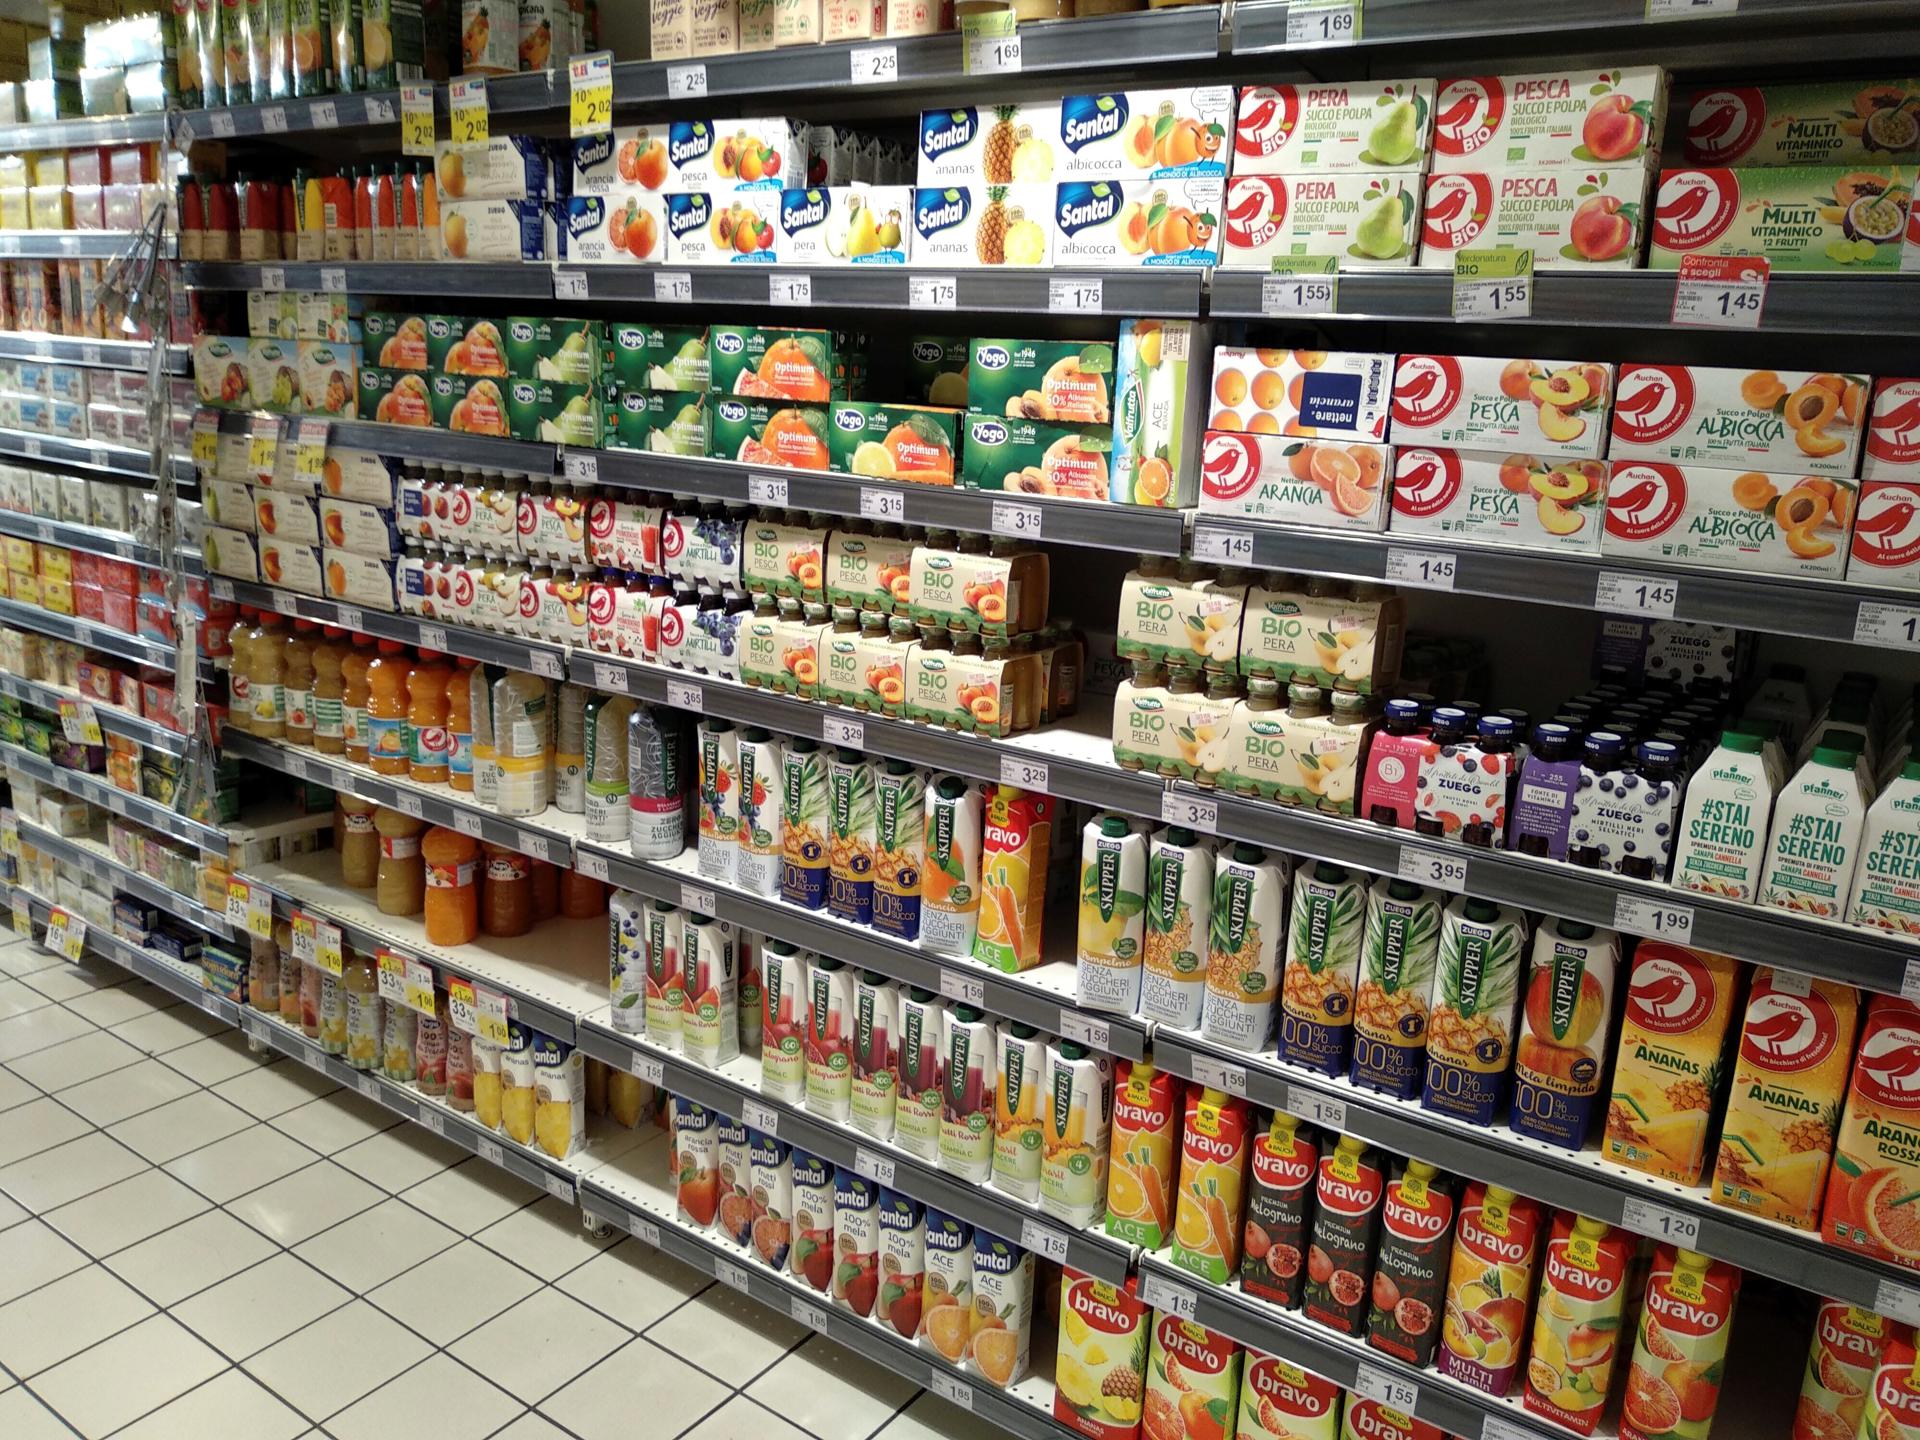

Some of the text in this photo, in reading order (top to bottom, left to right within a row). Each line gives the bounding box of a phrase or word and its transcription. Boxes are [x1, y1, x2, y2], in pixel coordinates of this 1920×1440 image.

[1307, 89, 1348, 107] PERA
[1451, 86, 1478, 94] Auchan
[1513, 79, 1571, 101] PESCA
[1306, 108, 1372, 120] SUCCO E POLPA
[1066, 115, 1118, 143] Santal
[1305, 122, 1337, 130] BIOLOGICO
[1787, 121, 1837, 138] MULTI
[925, 117, 969, 152] Santal
[672, 132, 709, 159] Santal
[1261, 132, 1288, 155] BIO
[1775, 138, 1843, 150] VITAMINICO
[936, 164, 974, 174] ananas
[1067, 158, 1122, 170] albicocca
[682, 172, 708, 182] pesca
[1675, 177, 1706, 186] Auchan
[1296, 183, 1336, 200] PERA
[1501, 178, 1557, 197] PESCA
[672, 206, 708, 231] Santal
[784, 202, 824, 228] Santal
[919, 199, 962, 229] Santal
[1060, 199, 1113, 226] Santal
[1762, 208, 1816, 224] MULTI
[570, 210, 600, 232] Santal
[1252, 223, 1277, 246] BIO
[1451, 222, 1479, 248] BIO
[1751, 226, 1823, 237] VITAMINICO
[578, 242, 605, 250] arancia
[681, 242, 705, 253] pesca
[794, 241, 816, 250] pera
[929, 243, 968, 253] ananas
[1062, 243, 1116, 255] albicocca
[1763, 238, 1808, 246] 12 FRUTTI
[582, 251, 601, 259] rossa
[1684, 256, 1729, 267] Confronta
[1457, 265, 1478, 274] BIO
[1691, 268, 1721, 278] scegli
[512, 323, 533, 340] Yoga
[716, 333, 743, 354] Yoga
[977, 347, 1009, 369] Yoga
[1410, 362, 1435, 370] Auchan
[775, 362, 814, 374] Optimum
[1047, 380, 1097, 392] Optimum
[1634, 374, 1663, 382] Auchan
[1310, 397, 1354, 406] arancia
[1474, 393, 1494, 402] Succo
[1501, 394, 1519, 404] Polpa
[1125, 390, 1137, 439] Valfrutta
[1152, 403, 1163, 428] ACE
[1470, 404, 1519, 422] PESCA
[1717, 408, 1738, 417] Succo
[1747, 410, 1770, 420] Polpa
[972, 423, 1008, 444] Yoga
[1696, 417, 1785, 439] ALBICOCCA
[897, 443, 939, 456] Optimum
[1626, 472, 1655, 481] Auchan
[1259, 484, 1323, 505] ARANCIA
[1470, 495, 1519, 514] PESCA
[1688, 516, 1775, 540] ALBICOCCA
[686, 548, 717, 561] MIRTILLI
[923, 572, 953, 588] BIO
[923, 588, 953, 601] PESCA
[1142, 586, 1171, 599] Valfrutta
[1137, 604, 1173, 621] BIO
[1266, 601, 1302, 614] Valfrutta
[1139, 621, 1167, 633] PERA
[1261, 618, 1301, 637] BIO
[1264, 636, 1294, 650] PERA
[919, 674, 947, 690] BIO
[919, 688, 947, 700] PESCA
[1246, 737, 1284, 757] BIO
[706, 744, 715, 794] SKIPPER
[1248, 756, 1278, 770] PERA
[1713, 770, 1752, 784] pfanner
[1438, 779, 1482, 794] ZUEGG
[1804, 784, 1844, 799] pfanner
[884, 789, 896, 842] SKIPPER
[1597, 808, 1643, 823] ZUEGG
[1701, 799, 1751, 827] #STAI
[1591, 819, 1644, 834] MIRTILLI NERI
[1599, 826, 1635, 838] SELVATICI
[1690, 820, 1754, 848] SERENO
[1790, 814, 1841, 843] #STAI
[1098, 842, 1120, 850] ZUEGG
[1691, 841, 1716, 850] SPREMUTA
[1777, 835, 1846, 865] SERENO
[1694, 849, 1742, 865] CANAPA CANNELLA
[1100, 854, 1116, 911] SKIPPER
[1230, 880, 1247, 940] SKIPPER
[1462, 927, 1490, 938] ZUEGG
[978, 946, 1001, 960] ACE
[1082, 950, 1132, 967] Pompelmo
[1082, 964, 1112, 975] SENZA
[1460, 940, 1481, 1006] SKIPPER
[1651, 962, 1682, 976] Auchan
[1081, 972, 1129, 986] ZUCCHERI
[1081, 982, 1130, 996] AGGIUNTI
[1554, 960, 1577, 1026] SKIPPER
[1428, 1047, 1467, 1066] Ananas
[1635, 1045, 1699, 1075] ANANAS
[1516, 1063, 1595, 1095] Mela limpida
[1057, 1075, 1068, 1132] SKIPPER
[1462, 1089, 1494, 1102] SUCCO
[1749, 1085, 1819, 1114] ANANAS
[1115, 1102, 1164, 1125] bravo
[956, 1132, 980, 1142] Rossi
[1254, 1151, 1308, 1178] bravo
[1404, 1193, 1425, 1206] RAUCH
[1251, 1199, 1302, 1223] Melograno
[1385, 1200, 1442, 1231] bravo
[844, 1212, 870, 1228] 100%
[844, 1223, 867, 1239] mela
[1113, 1220, 1145, 1240] ACE
[1462, 1221, 1523, 1259] bravo
[1380, 1248, 1433, 1278] Melograno
[980, 1274, 1002, 1291] ACE
[1675, 1289, 1700, 1302] RAUCH
[1075, 1294, 1130, 1328] bravo
[1650, 1292, 1718, 1328] bravo
[1449, 1357, 1493, 1384] MULTI
